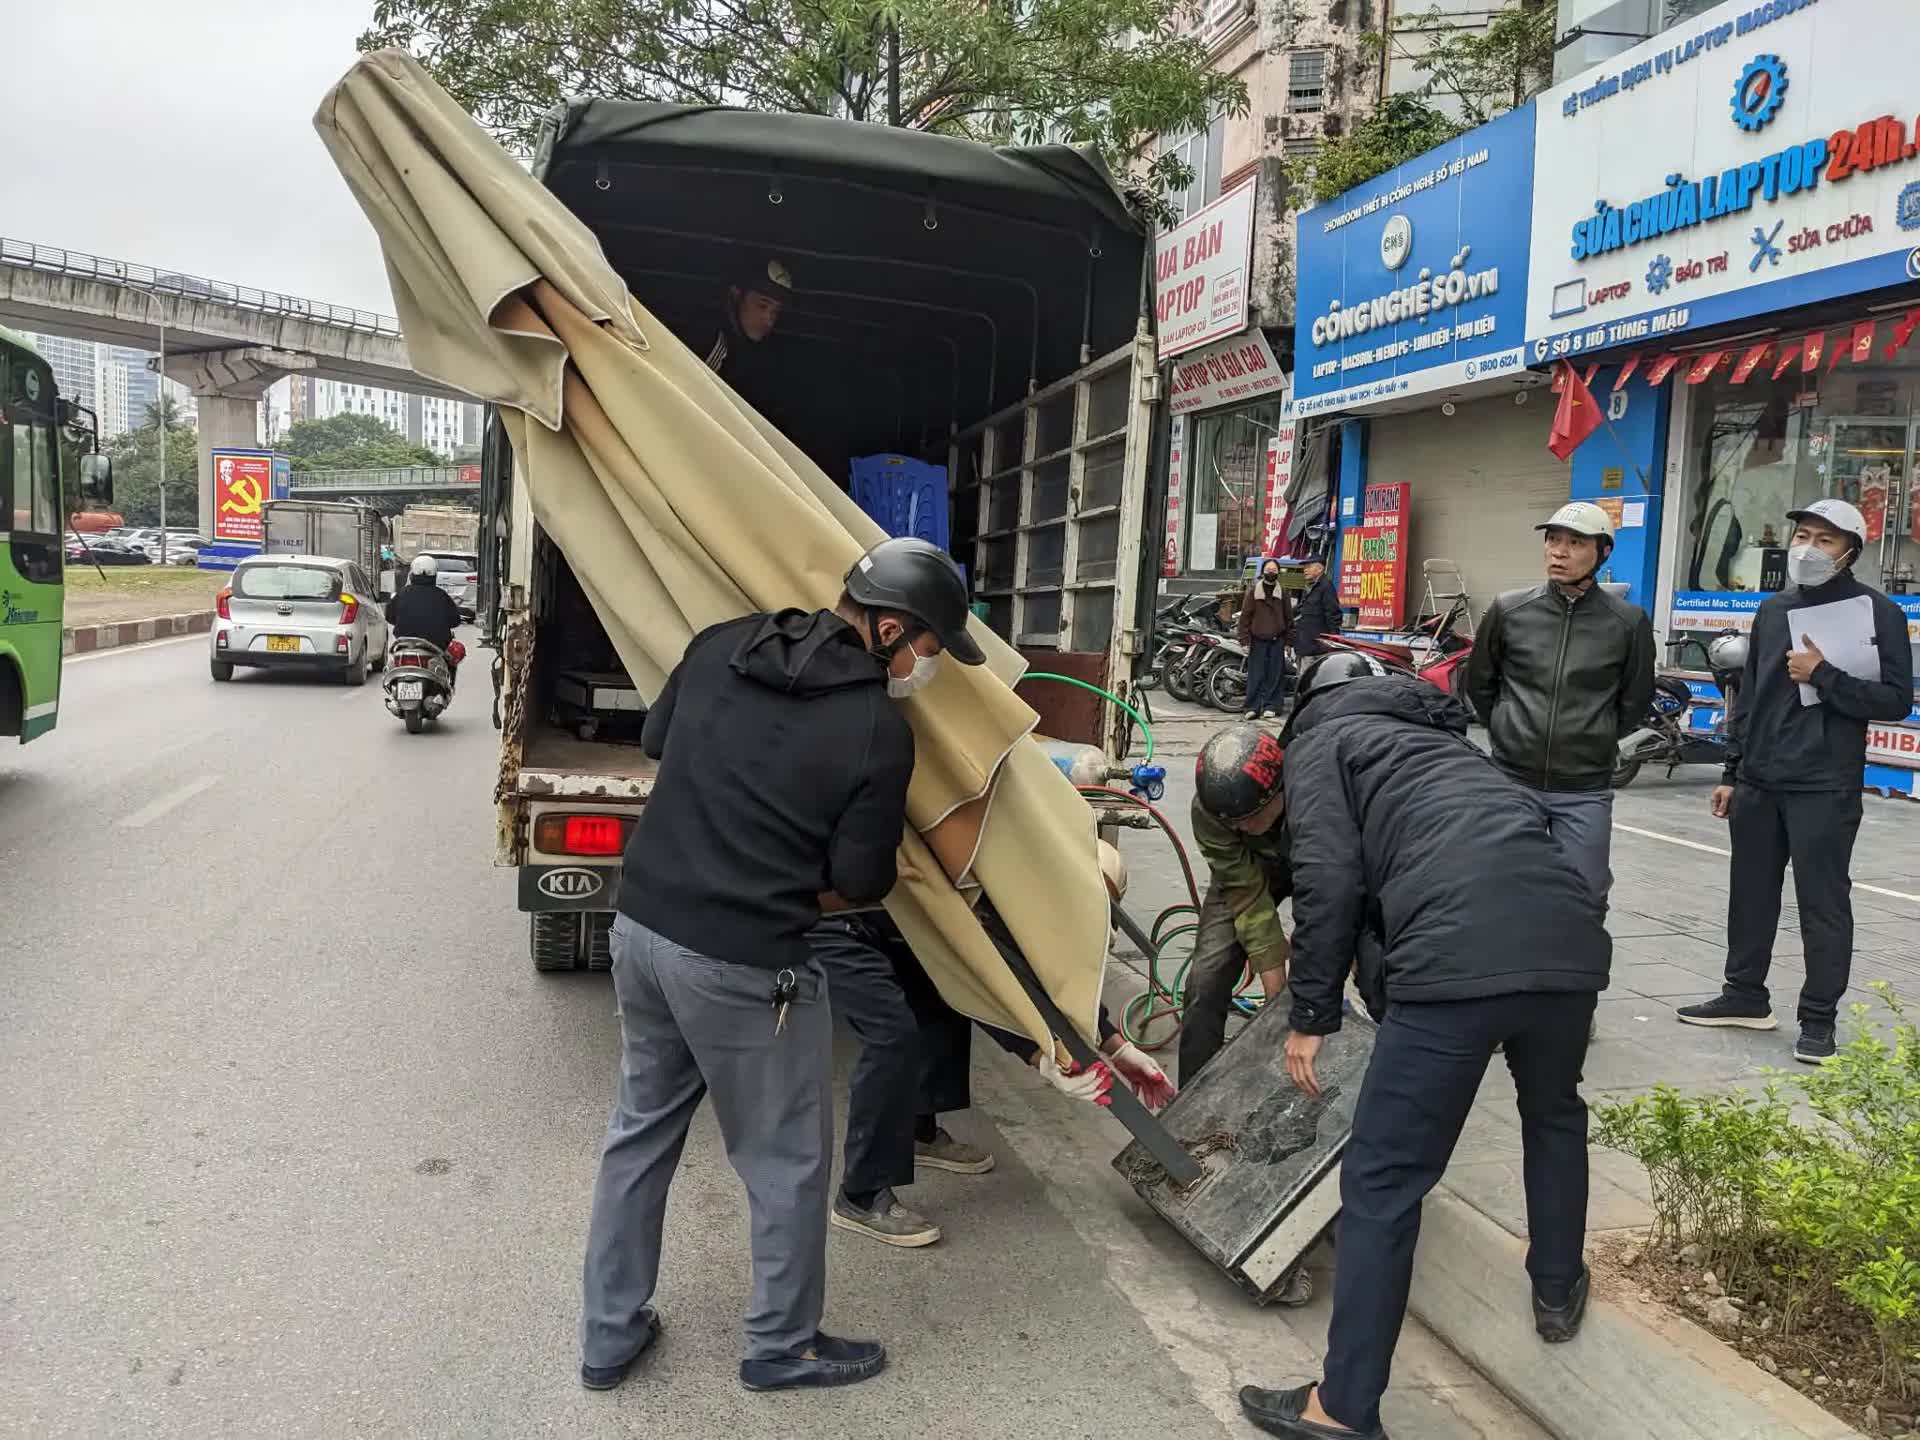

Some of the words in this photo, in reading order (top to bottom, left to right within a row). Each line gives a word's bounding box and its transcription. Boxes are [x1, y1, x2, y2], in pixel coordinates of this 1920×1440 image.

[1675, 22, 1734, 65] LAPTOP
[1323, 208, 1361, 234] SHOWROOM
[1363, 193, 1380, 216] THIẾT
[1389, 183, 1412, 204] CÔNG
[1413, 170, 1435, 193] NGHỆ
[1436, 160, 1448, 182] SỐ
[1449, 159, 1466, 177] VIỆT
[1467, 149, 1489, 169] NAM
[1788, 227, 1821, 253] SỬA
[1826, 213, 1874, 244] CHỮA
[1156, 245, 1178, 283] UA
[1183, 219, 1224, 271] BÁN
[1156, 274, 1206, 323] APTOP
[1588, 281, 1632, 306] LAPTOP
[1175, 322, 1196, 341] LAPTOP
[1551, 330, 1571, 355] SỐ
[1573, 333, 1582, 349] 8
[1585, 320, 1606, 349] HỒ
[1609, 315, 1649, 341] TÙNG
[1651, 307, 1690, 333] MẬU
[1312, 359, 1337, 379] LAPTOP
[1432, 326, 1450, 349] KIỆN
[1455, 321, 1474, 342] PHỤ
[1474, 314, 1496, 338] KIỆN
[1178, 360, 1211, 392] LAPTOP
[1222, 347, 1246, 378] GIÁ
[1240, 343, 1268, 373] CAO
[1480, 357, 1498, 373] 1800
[1613, 396, 1621, 415] 8
[1277, 450, 1290, 465] LAP
[1276, 473, 1289, 488] TOP
[1676, 597, 1710, 608] Certified
[1712, 598, 1730, 609] Mac
[1674, 615, 1697, 627] LAPTOP
[1703, 616, 1736, 628] MACBOOK
[549, 875, 593, 892] KIA
